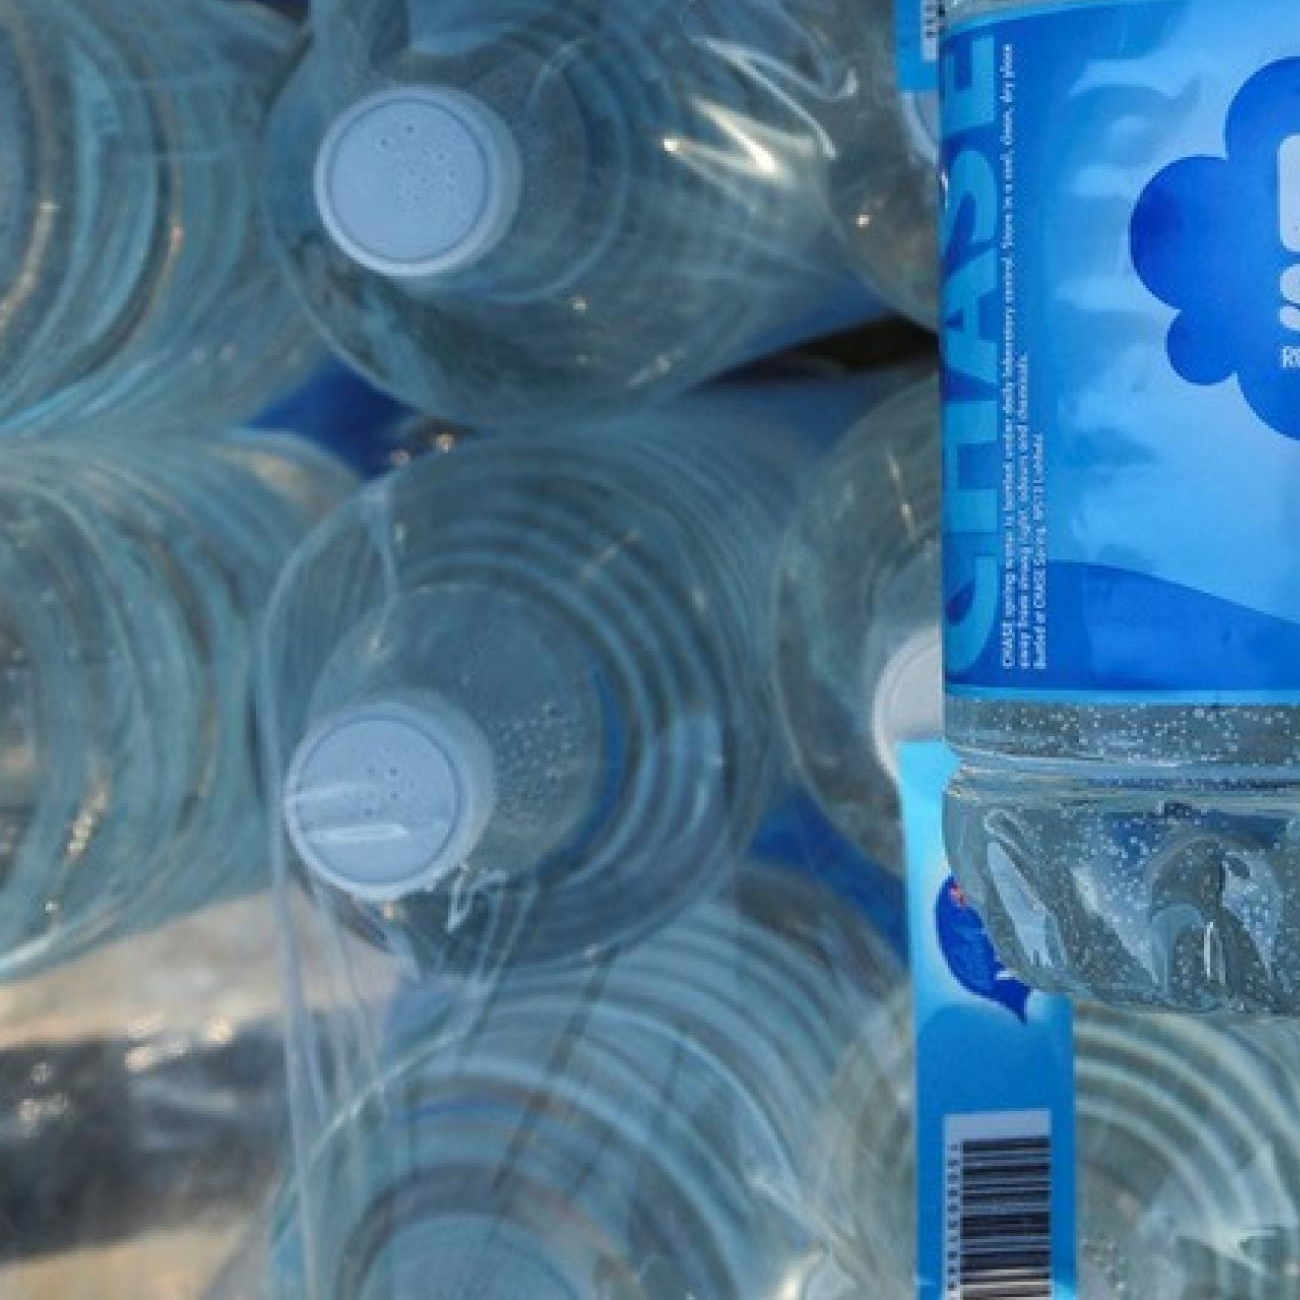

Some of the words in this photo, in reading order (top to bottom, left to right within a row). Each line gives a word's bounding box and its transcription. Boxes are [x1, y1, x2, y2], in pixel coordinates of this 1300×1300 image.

[1015, 424, 1028, 452] and
[1002, 461, 1014, 512] bottled
[1002, 573, 1015, 619] spring
[1031, 568, 1046, 609] CHASE
[1016, 595, 1029, 628] from
[1002, 619, 1015, 669] CHASE
